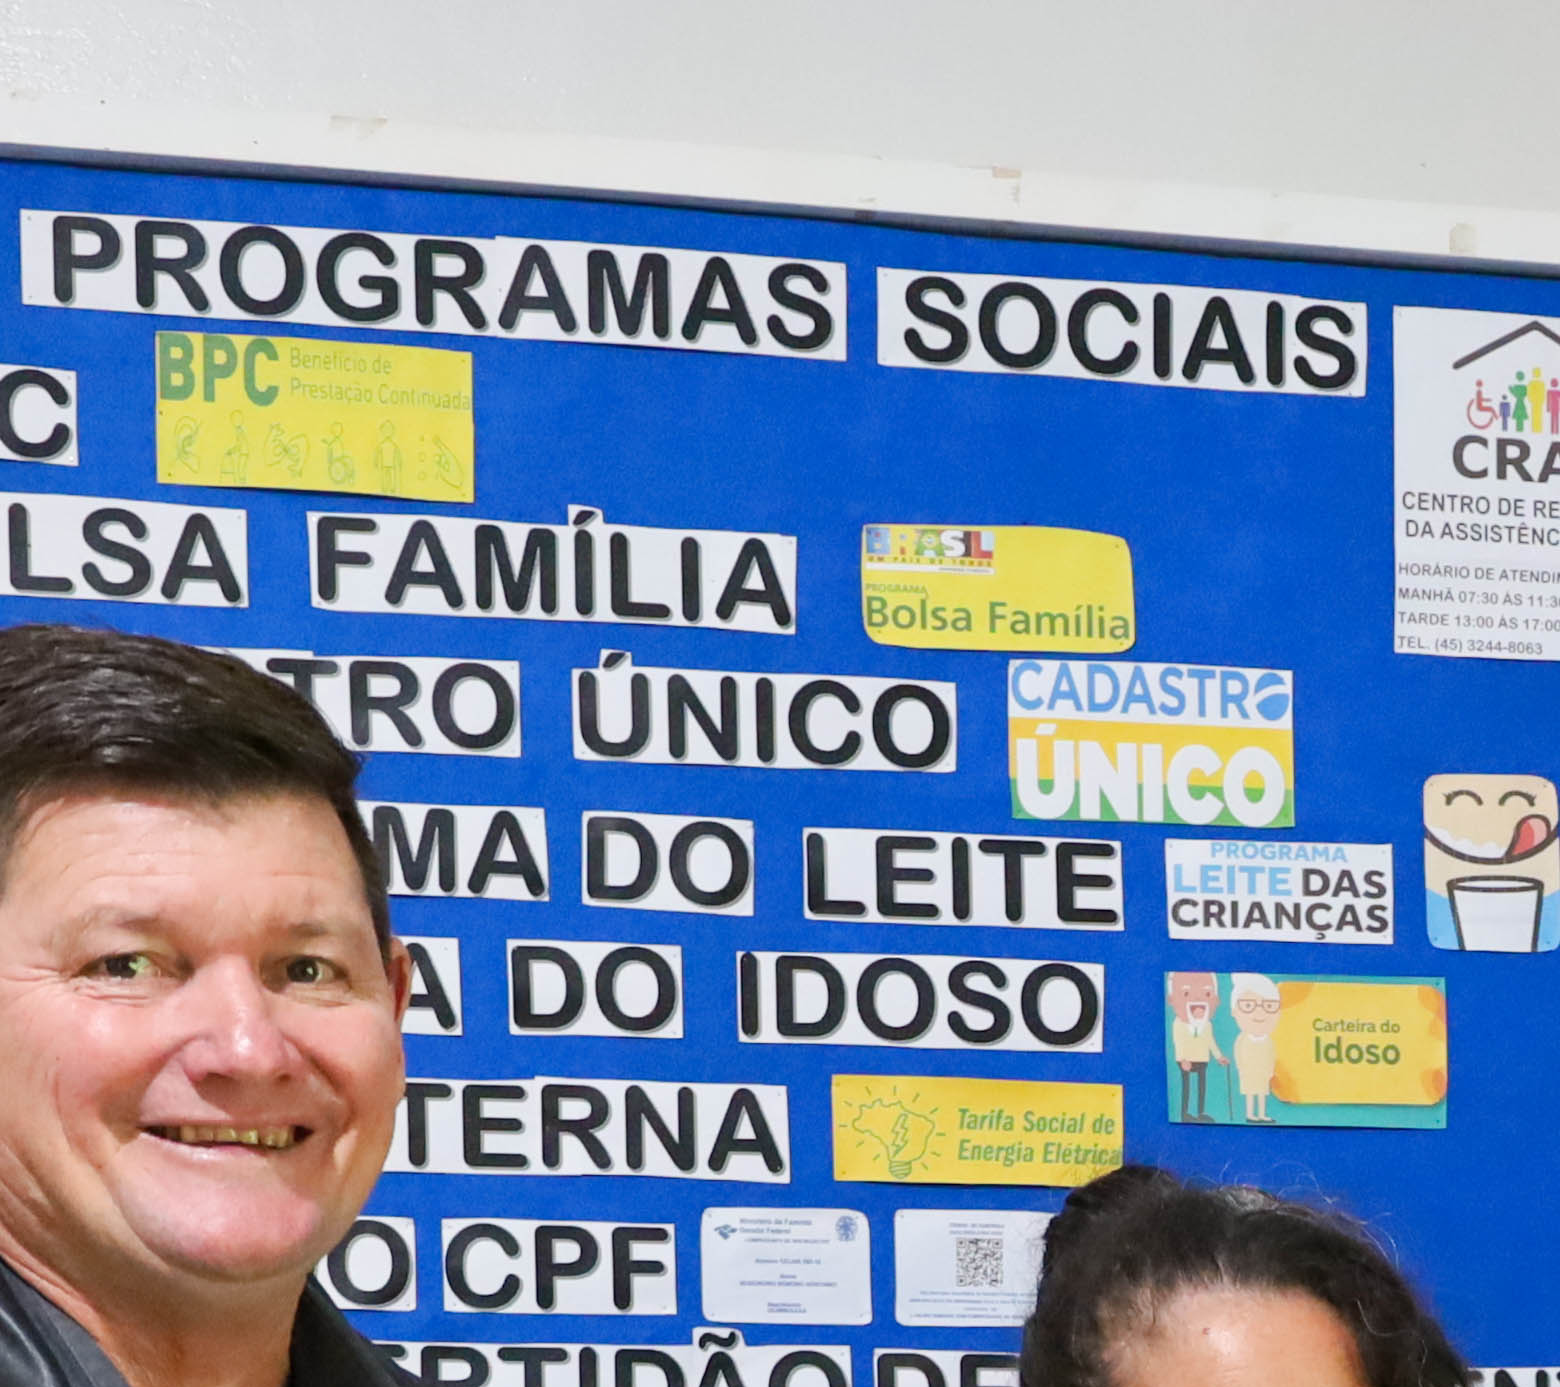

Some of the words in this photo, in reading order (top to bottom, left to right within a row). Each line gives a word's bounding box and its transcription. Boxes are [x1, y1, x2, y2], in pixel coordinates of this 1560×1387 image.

[51, 214, 833, 352] PROGRAMAS
[901, 274, 1358, 390] SOCIAIS
[159, 332, 279, 406] BPC
[378, 383, 472, 411] Continuada
[1402, 491, 1490, 514] CENTRO
[1498, 498, 1526, 517] DE
[1406, 520, 1435, 538] DA
[316, 509, 791, 628] FAMÍLIA
[1398, 562, 1470, 580] HORÁRIO
[1474, 568, 1495, 580] DE
[1398, 586, 1455, 603] MANHÃ
[1458, 592, 1498, 605] 07:30
[865, 595, 973, 632] Bolsa
[989, 600, 1130, 640] Família
[1398, 611, 1450, 626] TARDE
[1455, 615, 1494, 628] 13:00
[1398, 636, 1428, 650] TEL.
[1434, 638, 1462, 653] (45)
[1011, 660, 1290, 721] CADASTRO
[578, 650, 951, 767] ÚNICO
[1016, 723, 1285, 827] ÚNICO
[1210, 842, 1348, 863] PROGRAMA
[586, 817, 751, 908] DO
[807, 832, 1120, 925] LEITE
[1173, 864, 1293, 896] LEITE
[1302, 868, 1387, 899] DAS
[1171, 898, 1389, 940] CRIANÇAS
[508, 946, 678, 1033] DO
[739, 951, 1100, 1047] IDOSO
[1312, 1019, 1377, 1033] Carteira
[1380, 1019, 1400, 1033] do
[1314, 1037, 1401, 1064] Idoso
[958, 1108, 1014, 1131] Tarifa
[1023, 1110, 1086, 1134] Social
[1092, 1113, 1115, 1135] de
[958, 1139, 1034, 1167] Energia
[1042, 1140, 1124, 1166] Elétrica
[445, 1223, 669, 1310] CPF
